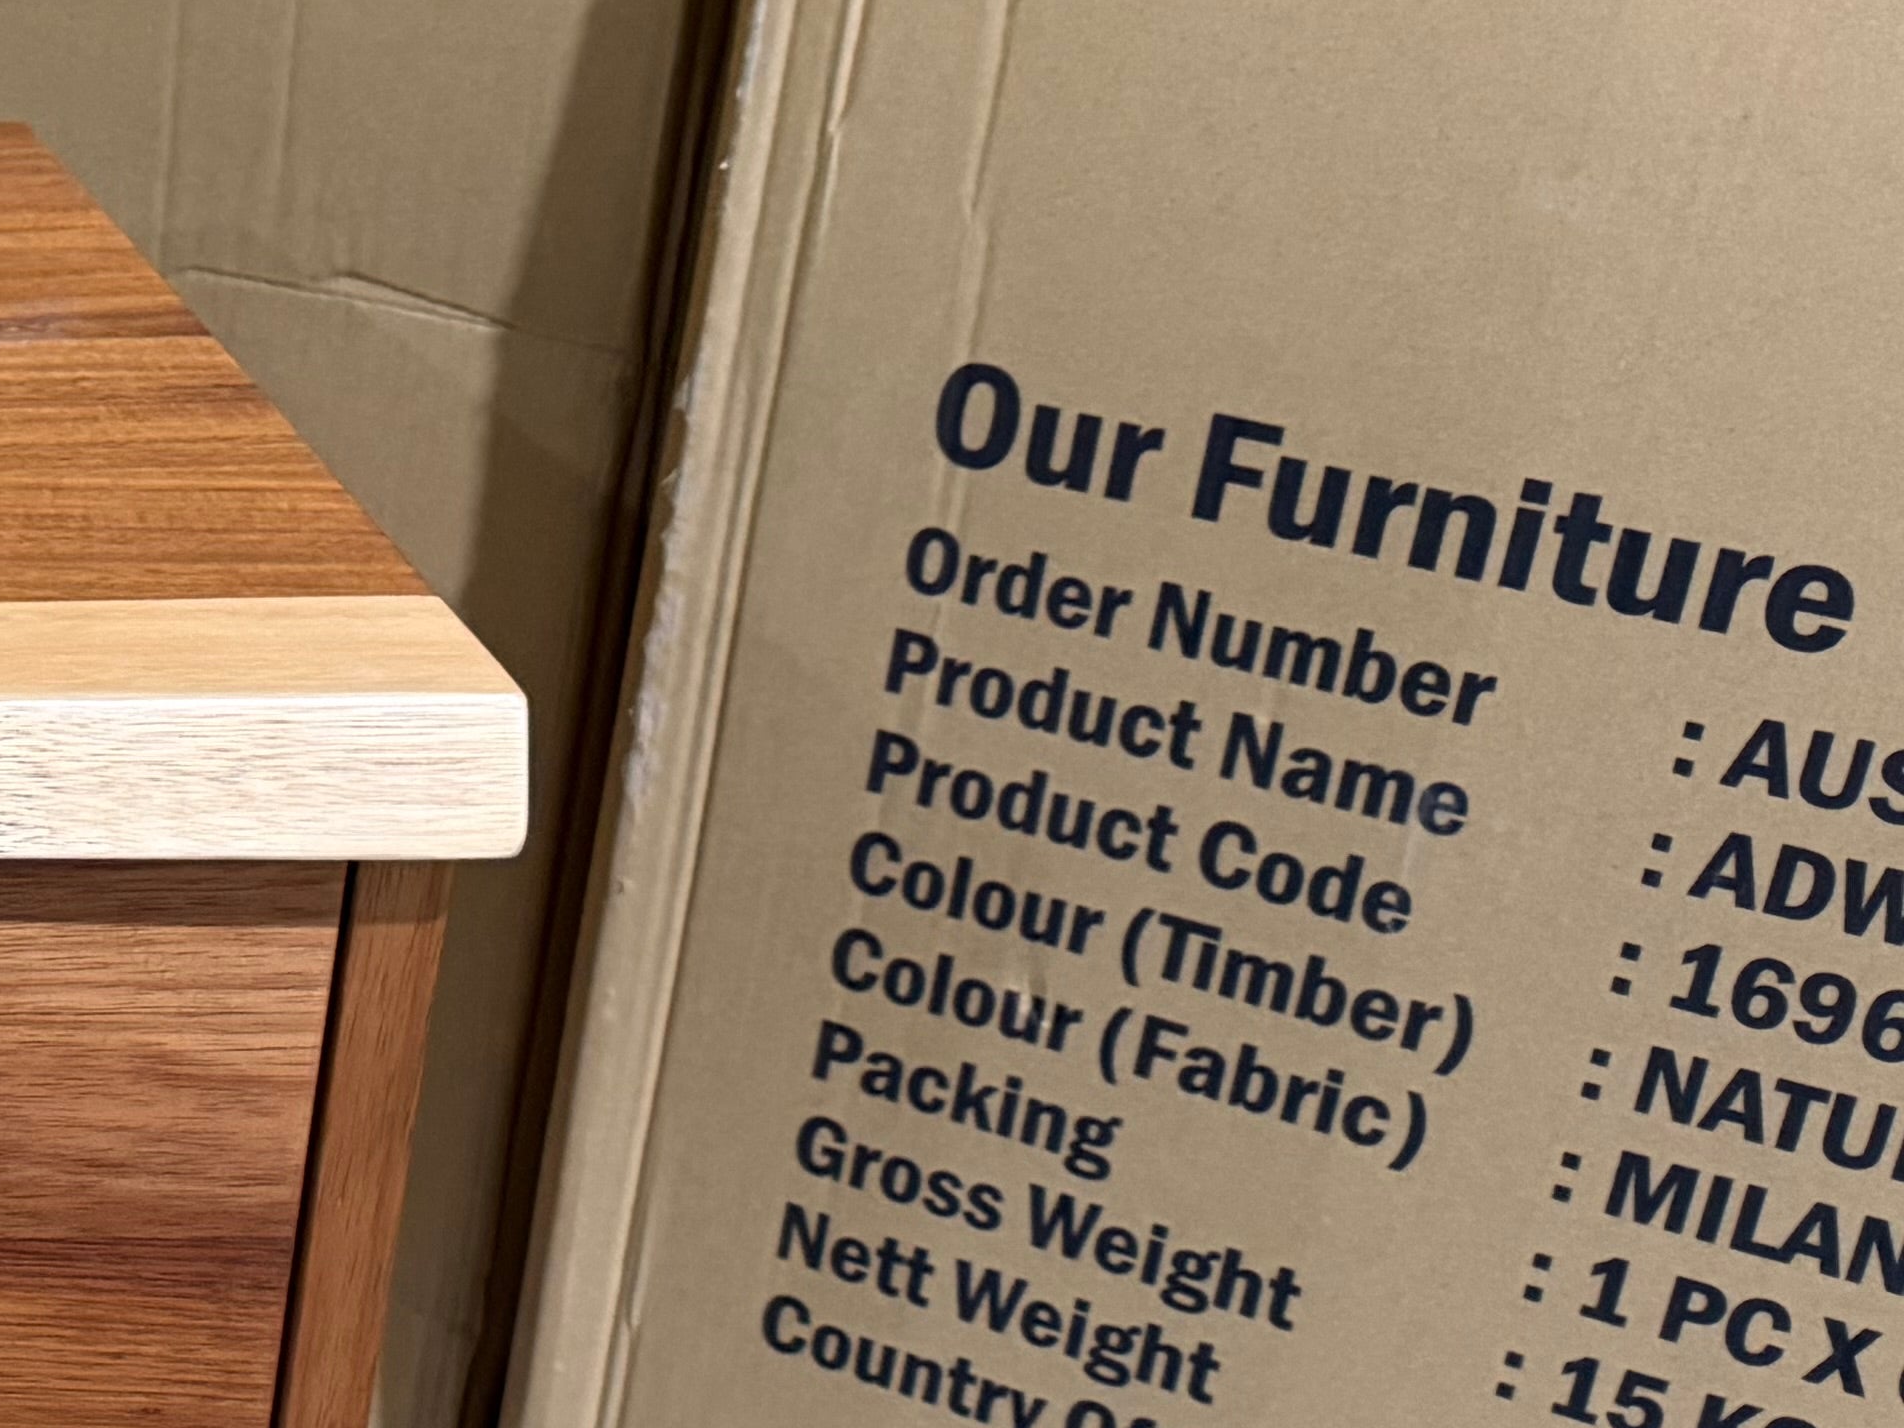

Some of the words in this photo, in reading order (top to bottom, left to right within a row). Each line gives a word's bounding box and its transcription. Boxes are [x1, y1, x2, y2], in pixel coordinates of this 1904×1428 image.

[904, 525, 1135, 639] Order
[1146, 580, 1499, 727] Number
[934, 361, 1167, 504] Our
[1189, 411, 1856, 655] Furniture
[864, 727, 1181, 875] Product
[1197, 819, 1413, 936] Code
[1668, 942, 1904, 1064] 1696
[883, 626, 1204, 772] Product
[1218, 710, 1470, 837] Name
[1685, 830, 1904, 948] ADW
[829, 926, 1085, 1054] Colour
[1097, 1005, 1428, 1173] (Fabric)
[1603, 1149, 1904, 1297] MILAN
[848, 830, 1107, 956] Colour
[1119, 906, 1475, 1078] (Timber)
[1632, 1044, 1904, 1184] NATU
[775, 1200, 937, 1309] Nett
[954, 1257, 1222, 1406] Weight
[794, 1114, 1005, 1233] Gross
[1027, 1182, 1303, 1333] Weight
[809, 1017, 1125, 1183] Packing
[1578, 1256, 1631, 1329] 1
[1657, 1274, 1793, 1368] PC
[1800, 1315, 1884, 1399] X
